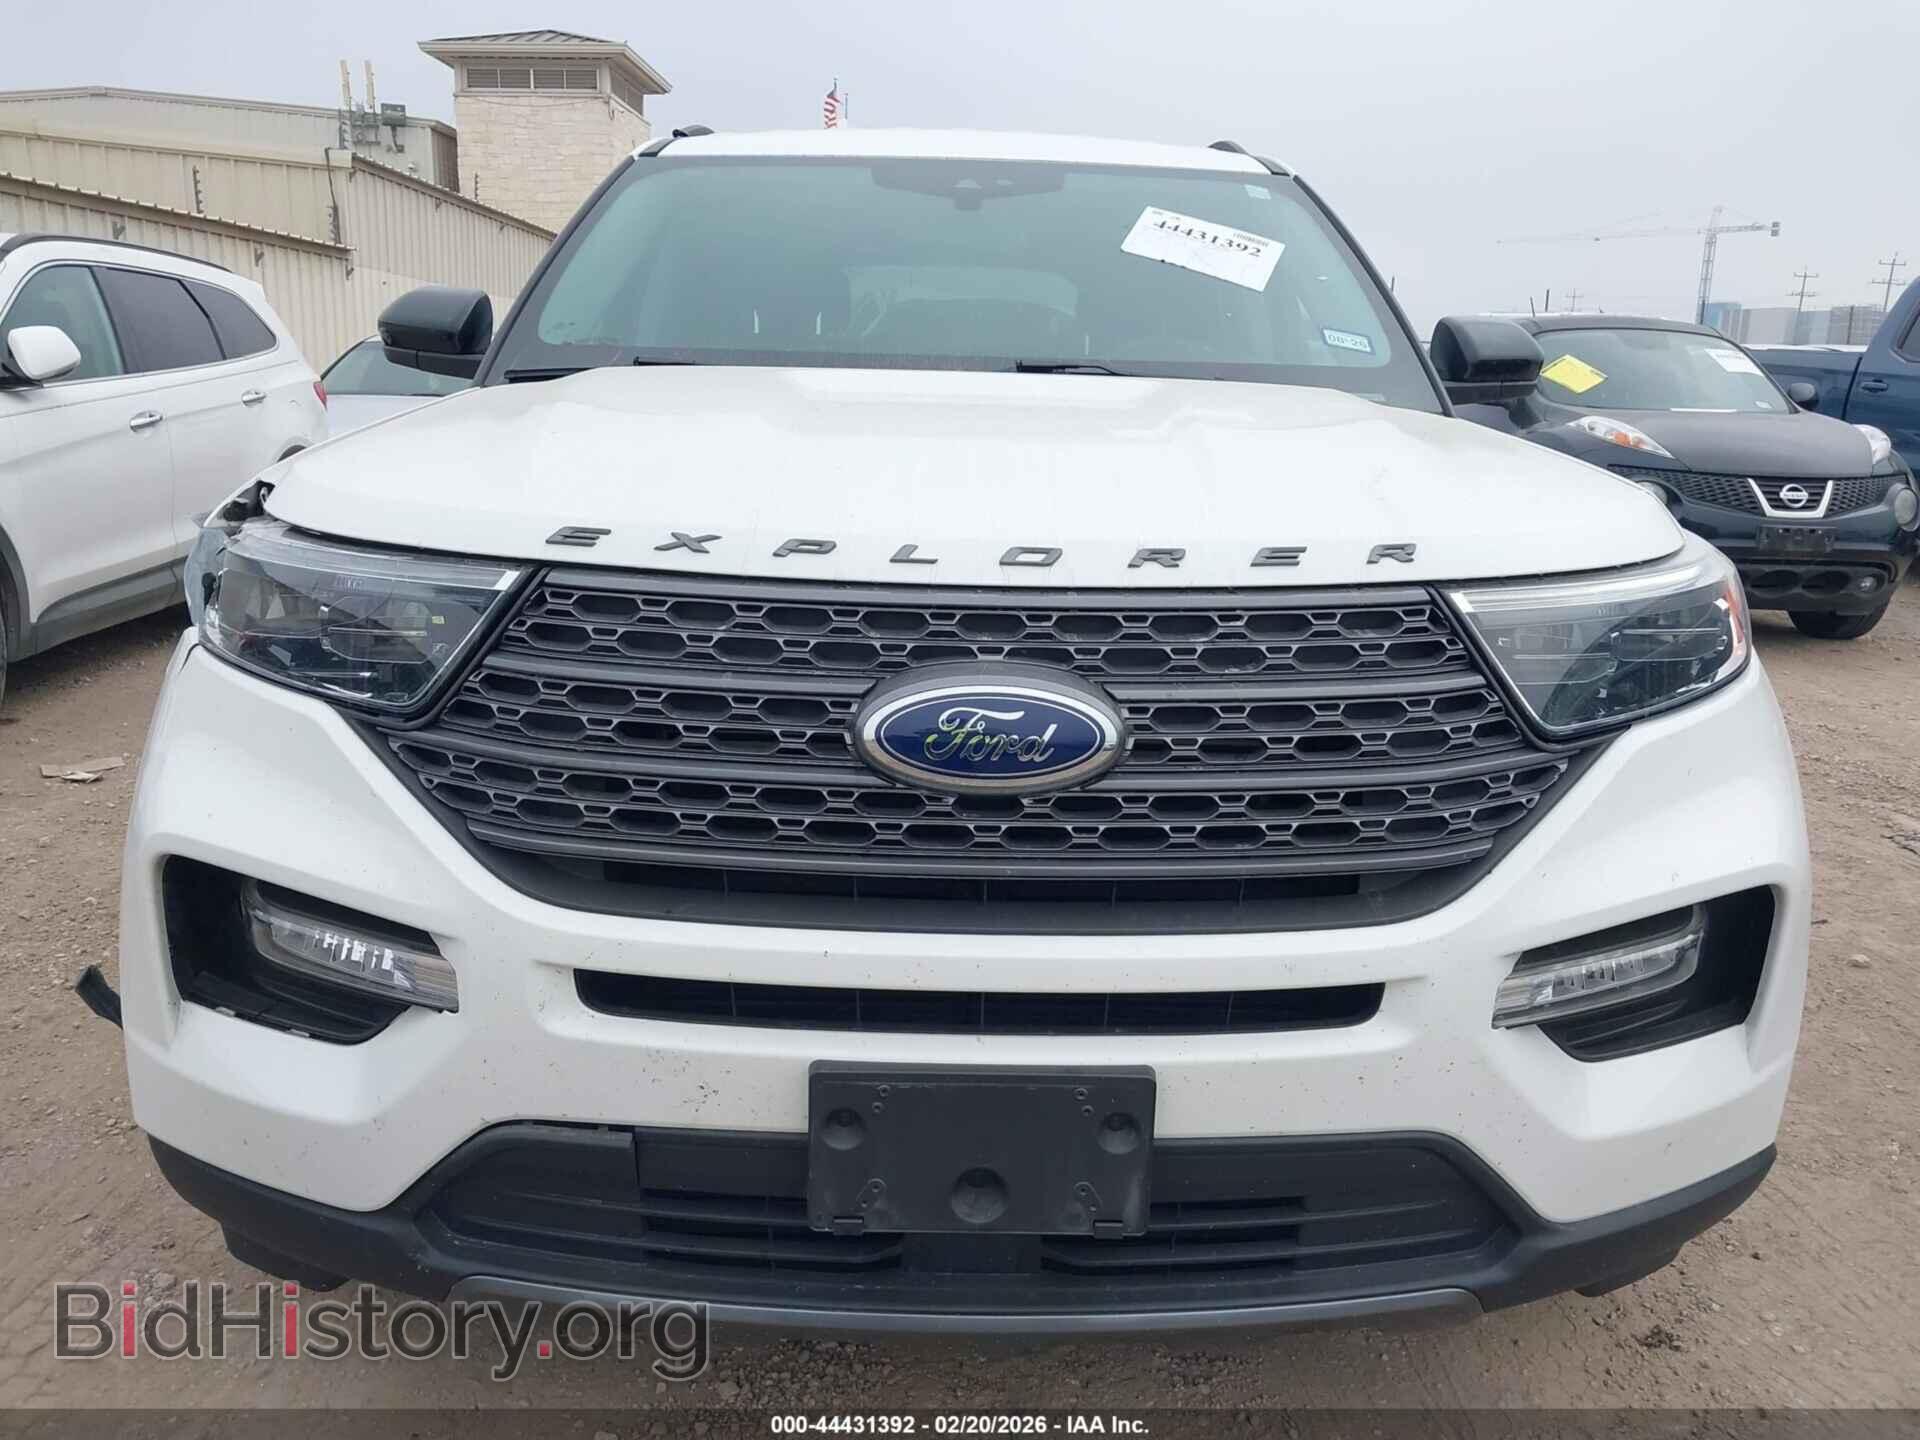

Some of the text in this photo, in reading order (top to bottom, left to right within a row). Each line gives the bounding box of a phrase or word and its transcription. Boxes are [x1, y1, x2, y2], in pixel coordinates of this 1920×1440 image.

[1153, 220, 1261, 256] 44431392
[545, 526, 1418, 569] EXPLORER
[924, 706, 1058, 762] Ford
